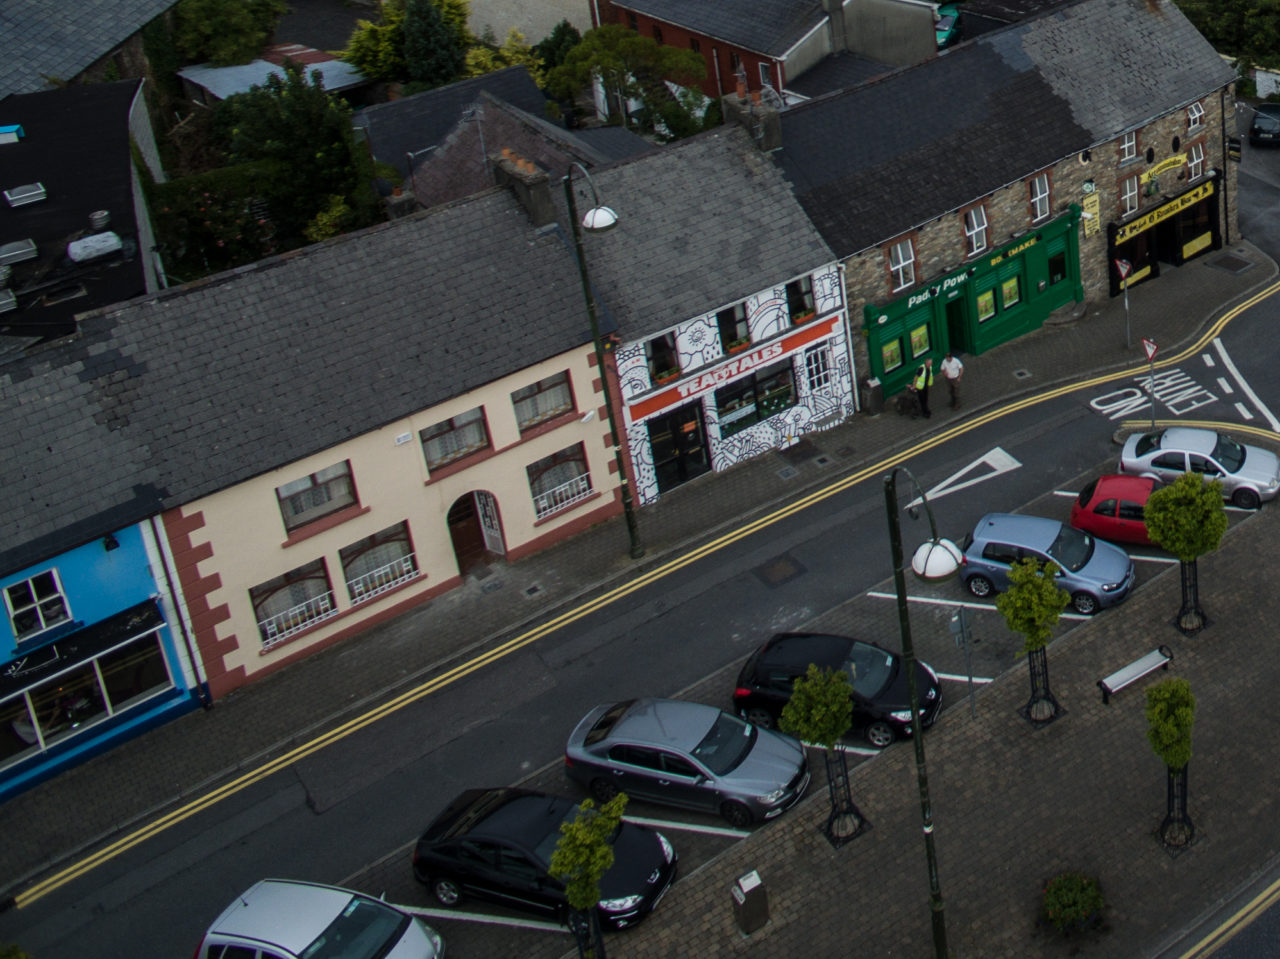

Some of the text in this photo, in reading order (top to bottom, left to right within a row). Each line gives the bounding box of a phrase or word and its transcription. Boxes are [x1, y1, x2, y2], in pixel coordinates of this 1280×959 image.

[908, 267, 977, 308] Pady Pow
[677, 372, 716, 398] TEA
[724, 342, 783, 375] TALES
[1133, 368, 1220, 416] ENTRY
[1090, 387, 1152, 420] NO
